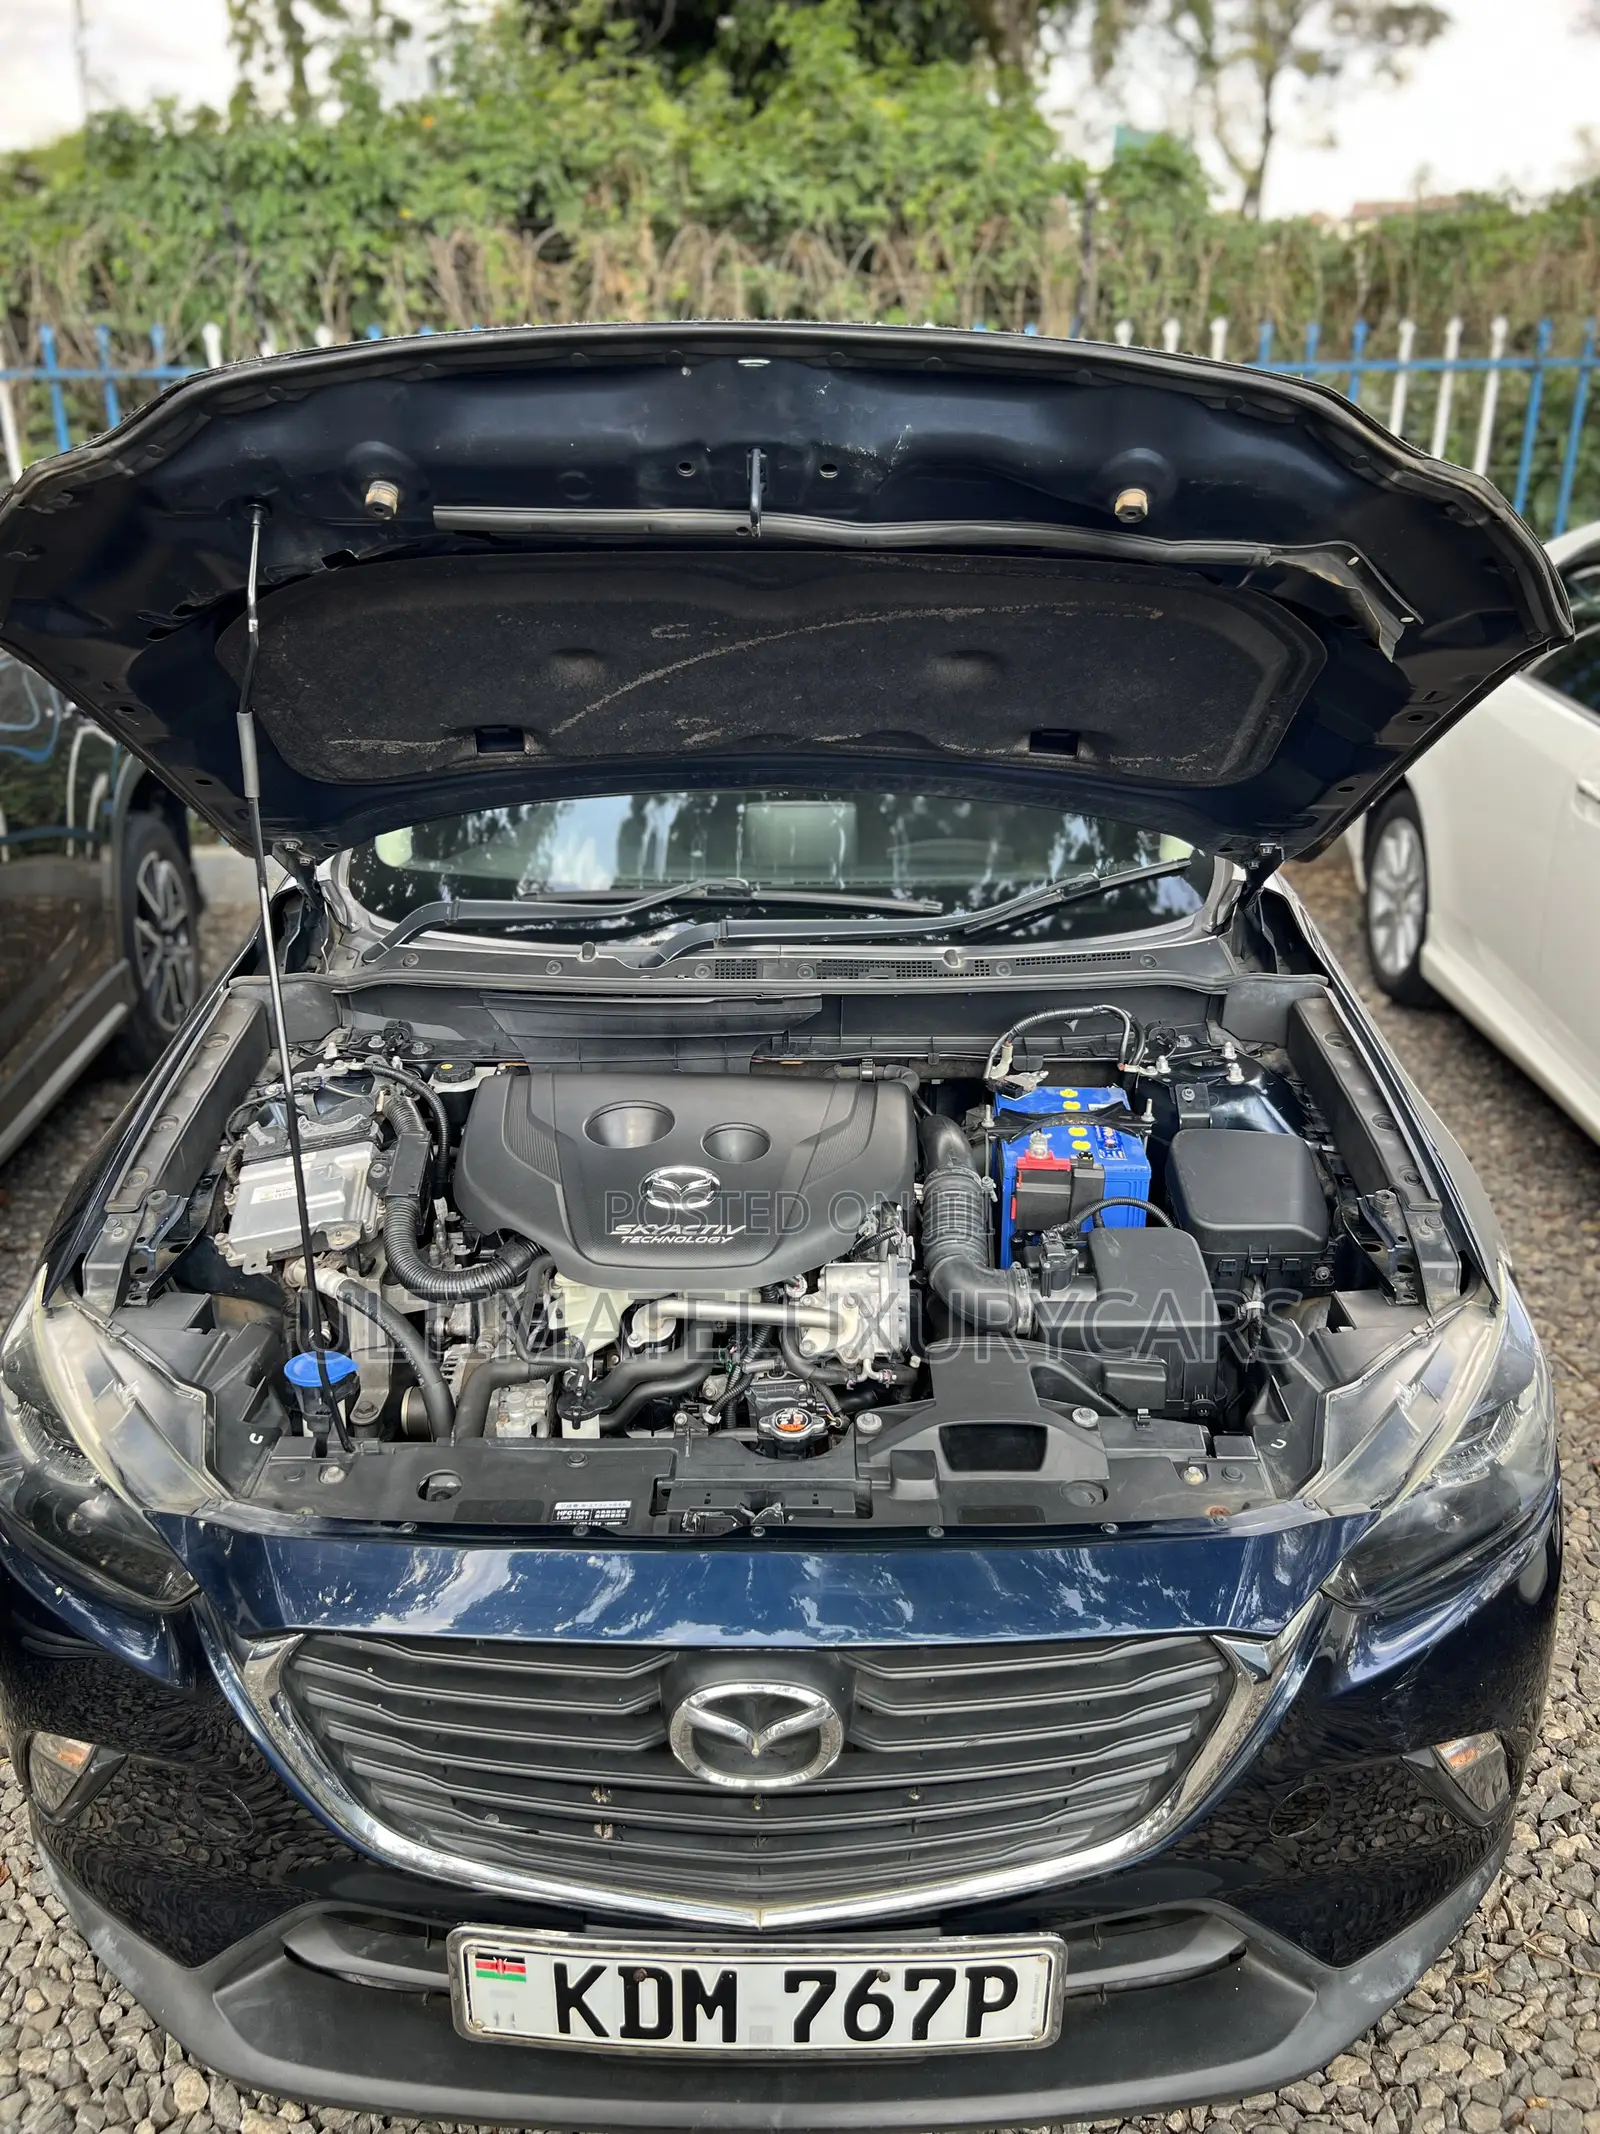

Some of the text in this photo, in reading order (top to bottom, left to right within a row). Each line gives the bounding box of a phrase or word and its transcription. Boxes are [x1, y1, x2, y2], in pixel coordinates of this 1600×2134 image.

[610, 1223, 747, 1236] SKYACTIV
[620, 1235, 735, 1245] TECHNOLOGY
[552, 1960, 738, 2043] KDM
[783, 1967, 1019, 2043] 767P
